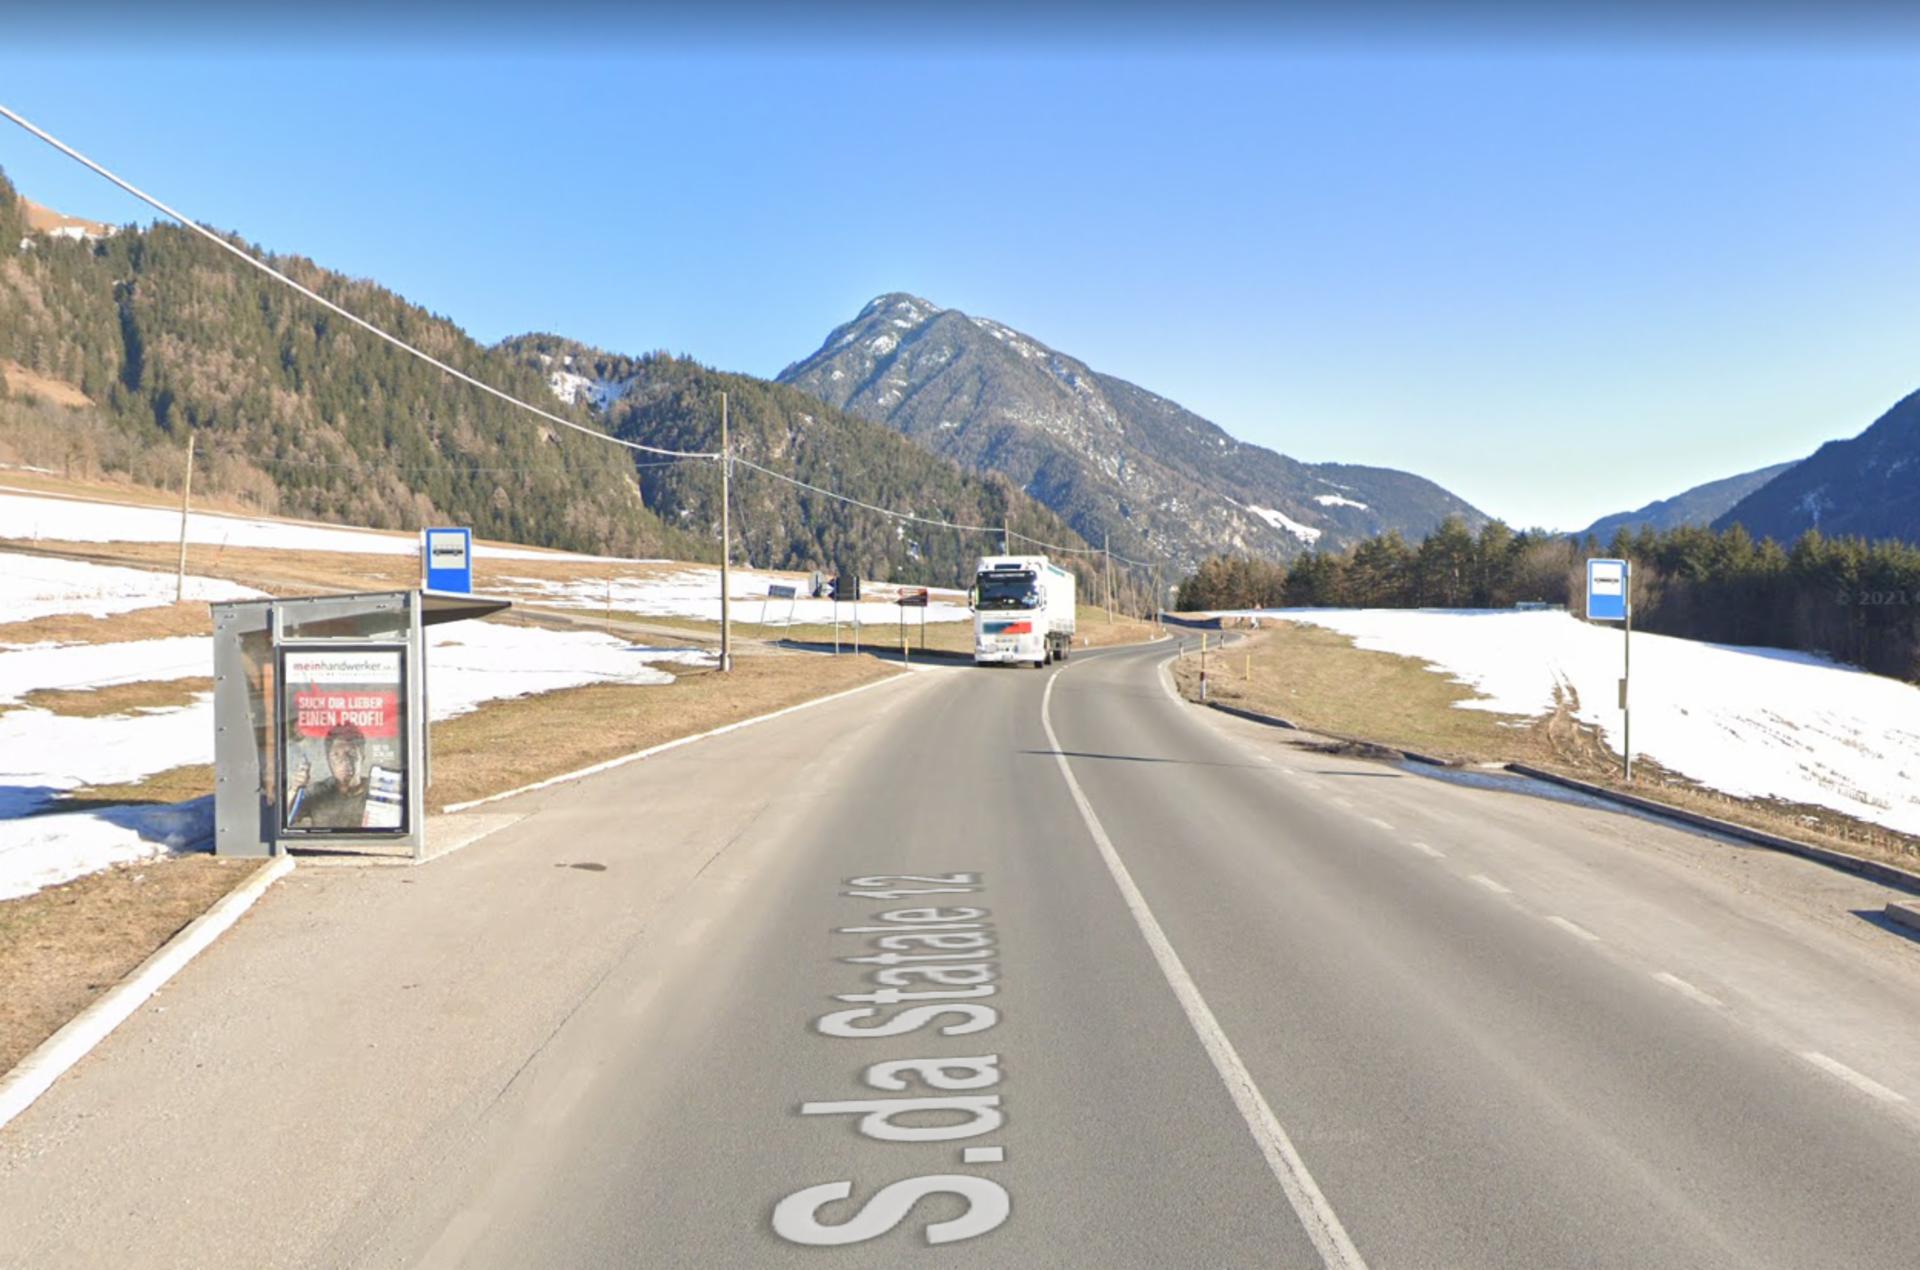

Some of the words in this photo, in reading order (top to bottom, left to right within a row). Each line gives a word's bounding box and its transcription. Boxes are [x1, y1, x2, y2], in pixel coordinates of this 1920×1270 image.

[298, 696, 325, 709] SUCH
[328, 696, 346, 709] DIR
[348, 696, 384, 709] LIEBER
[298, 711, 337, 727] EINEN
